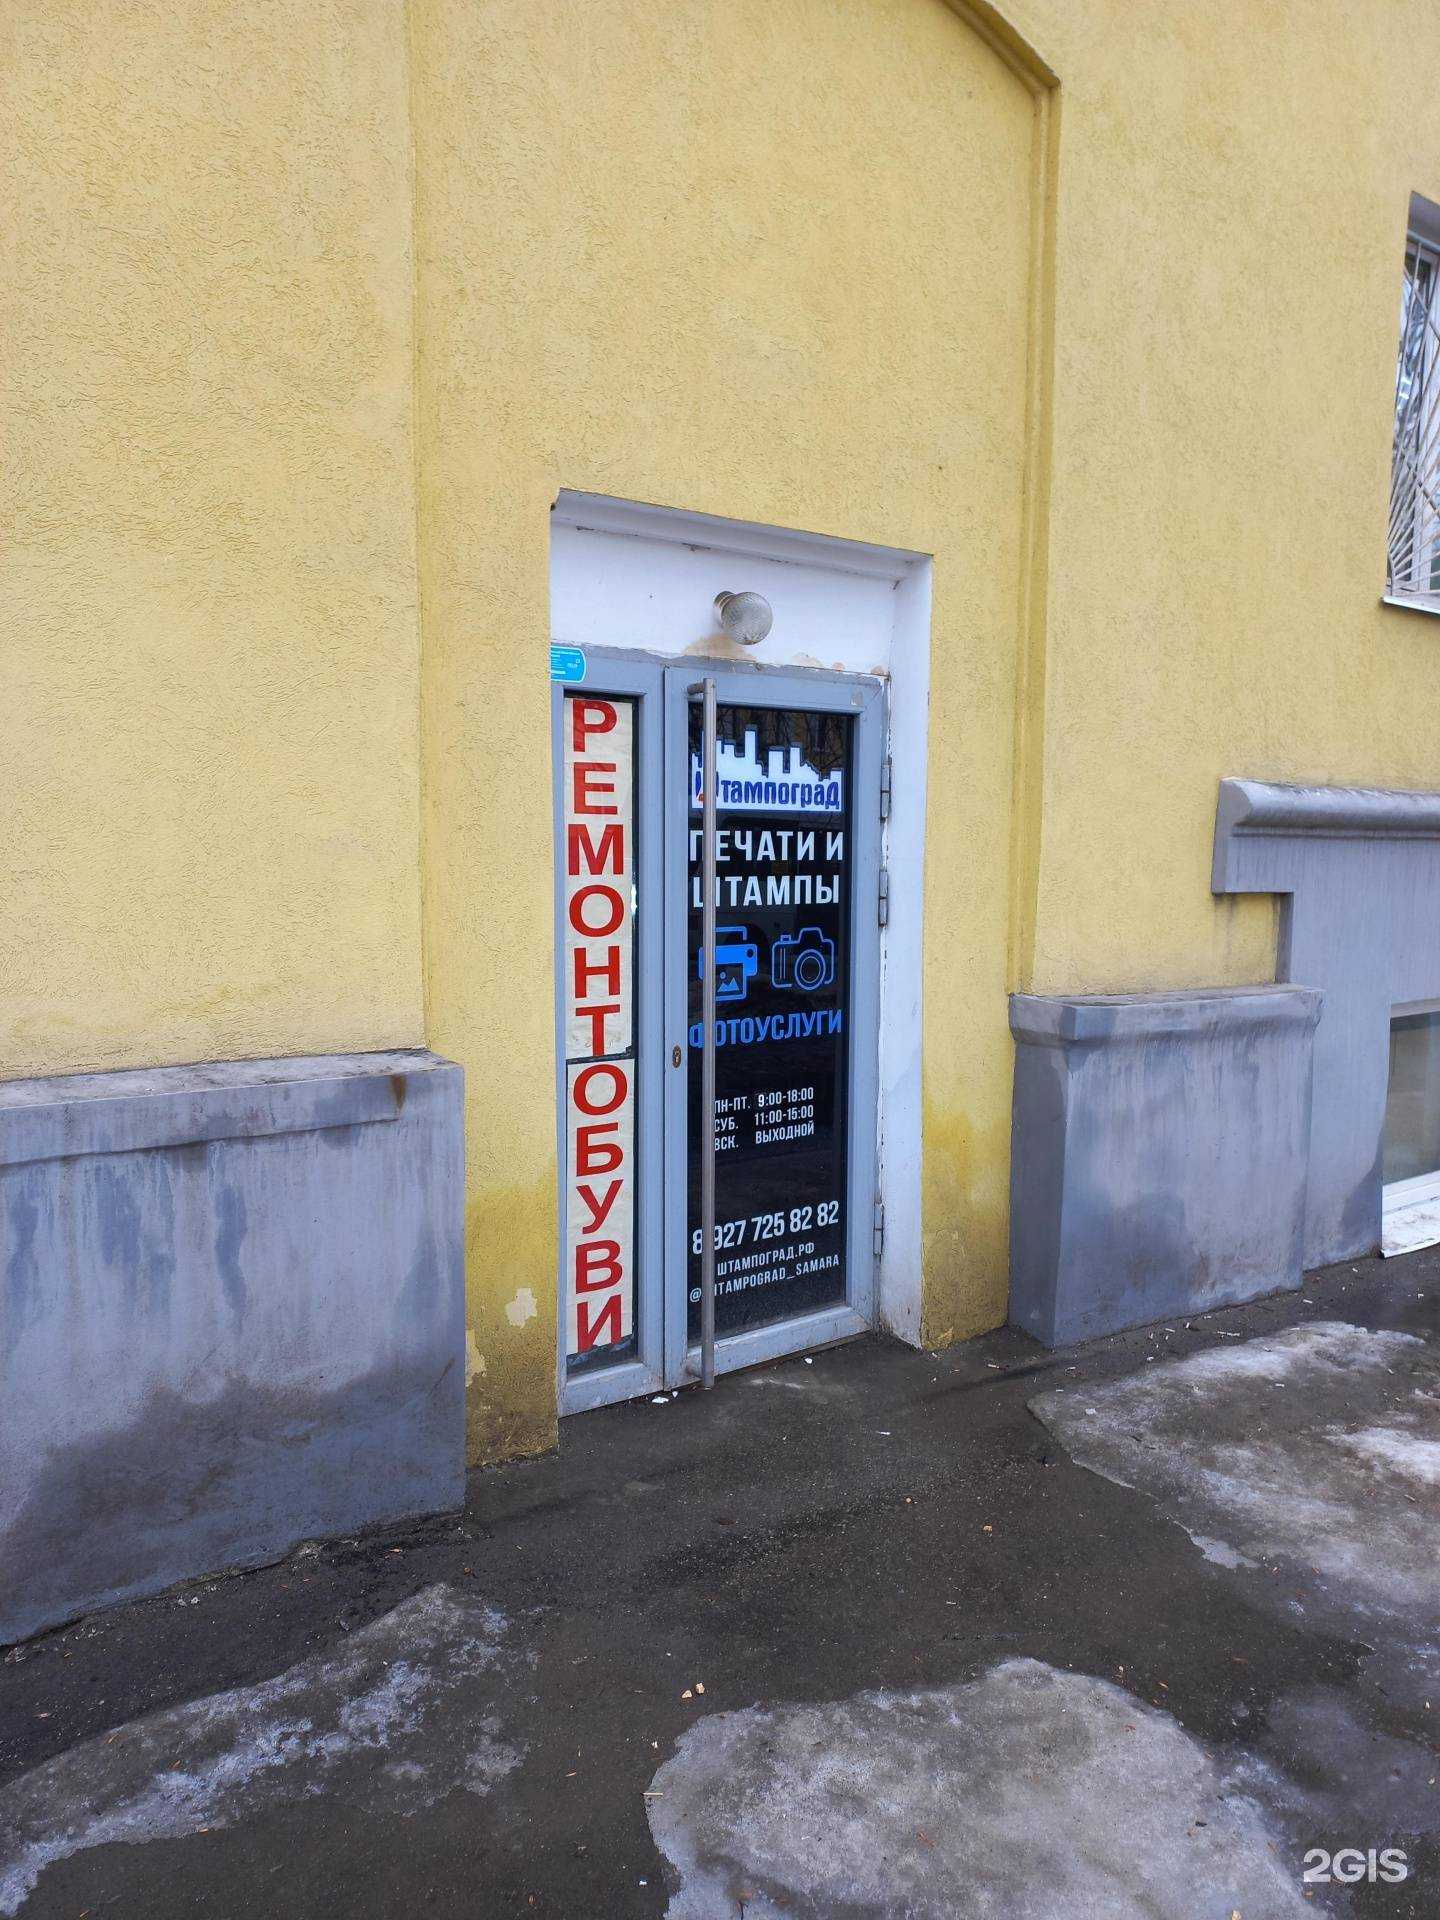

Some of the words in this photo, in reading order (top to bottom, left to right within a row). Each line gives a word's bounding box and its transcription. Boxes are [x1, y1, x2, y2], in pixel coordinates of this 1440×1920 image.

[690, 830, 815, 861] ПЕЧАТИ
[826, 832, 843, 860] И
[568, 699, 625, 1056] РЕМОНТ
[689, 1009, 842, 1048] ФОТОУСЛУГИ
[758, 1087, 814, 1107] 9:00-18:00
[715, 1117, 739, 1132] СУБ.
[755, 1105, 814, 1125] 11:00-15:00
[715, 1135, 739, 1150] ВСК.
[755, 1121, 814, 1144] ВЫХОДНОЙ
[573, 1064, 628, 1353] ОБУВИ
[692, 1229, 703, 1254] 8
[714, 1220, 746, 1250] 927
[751, 1211, 785, 1241] 725
[789, 1206, 813, 1232] 82
[817, 1200, 839, 1226] 82
[717, 1242, 815, 1276] ШТАМПОГРАД.РФ
[690, 1254, 840, 1303] @TAMPOGRAD_SAMARA
